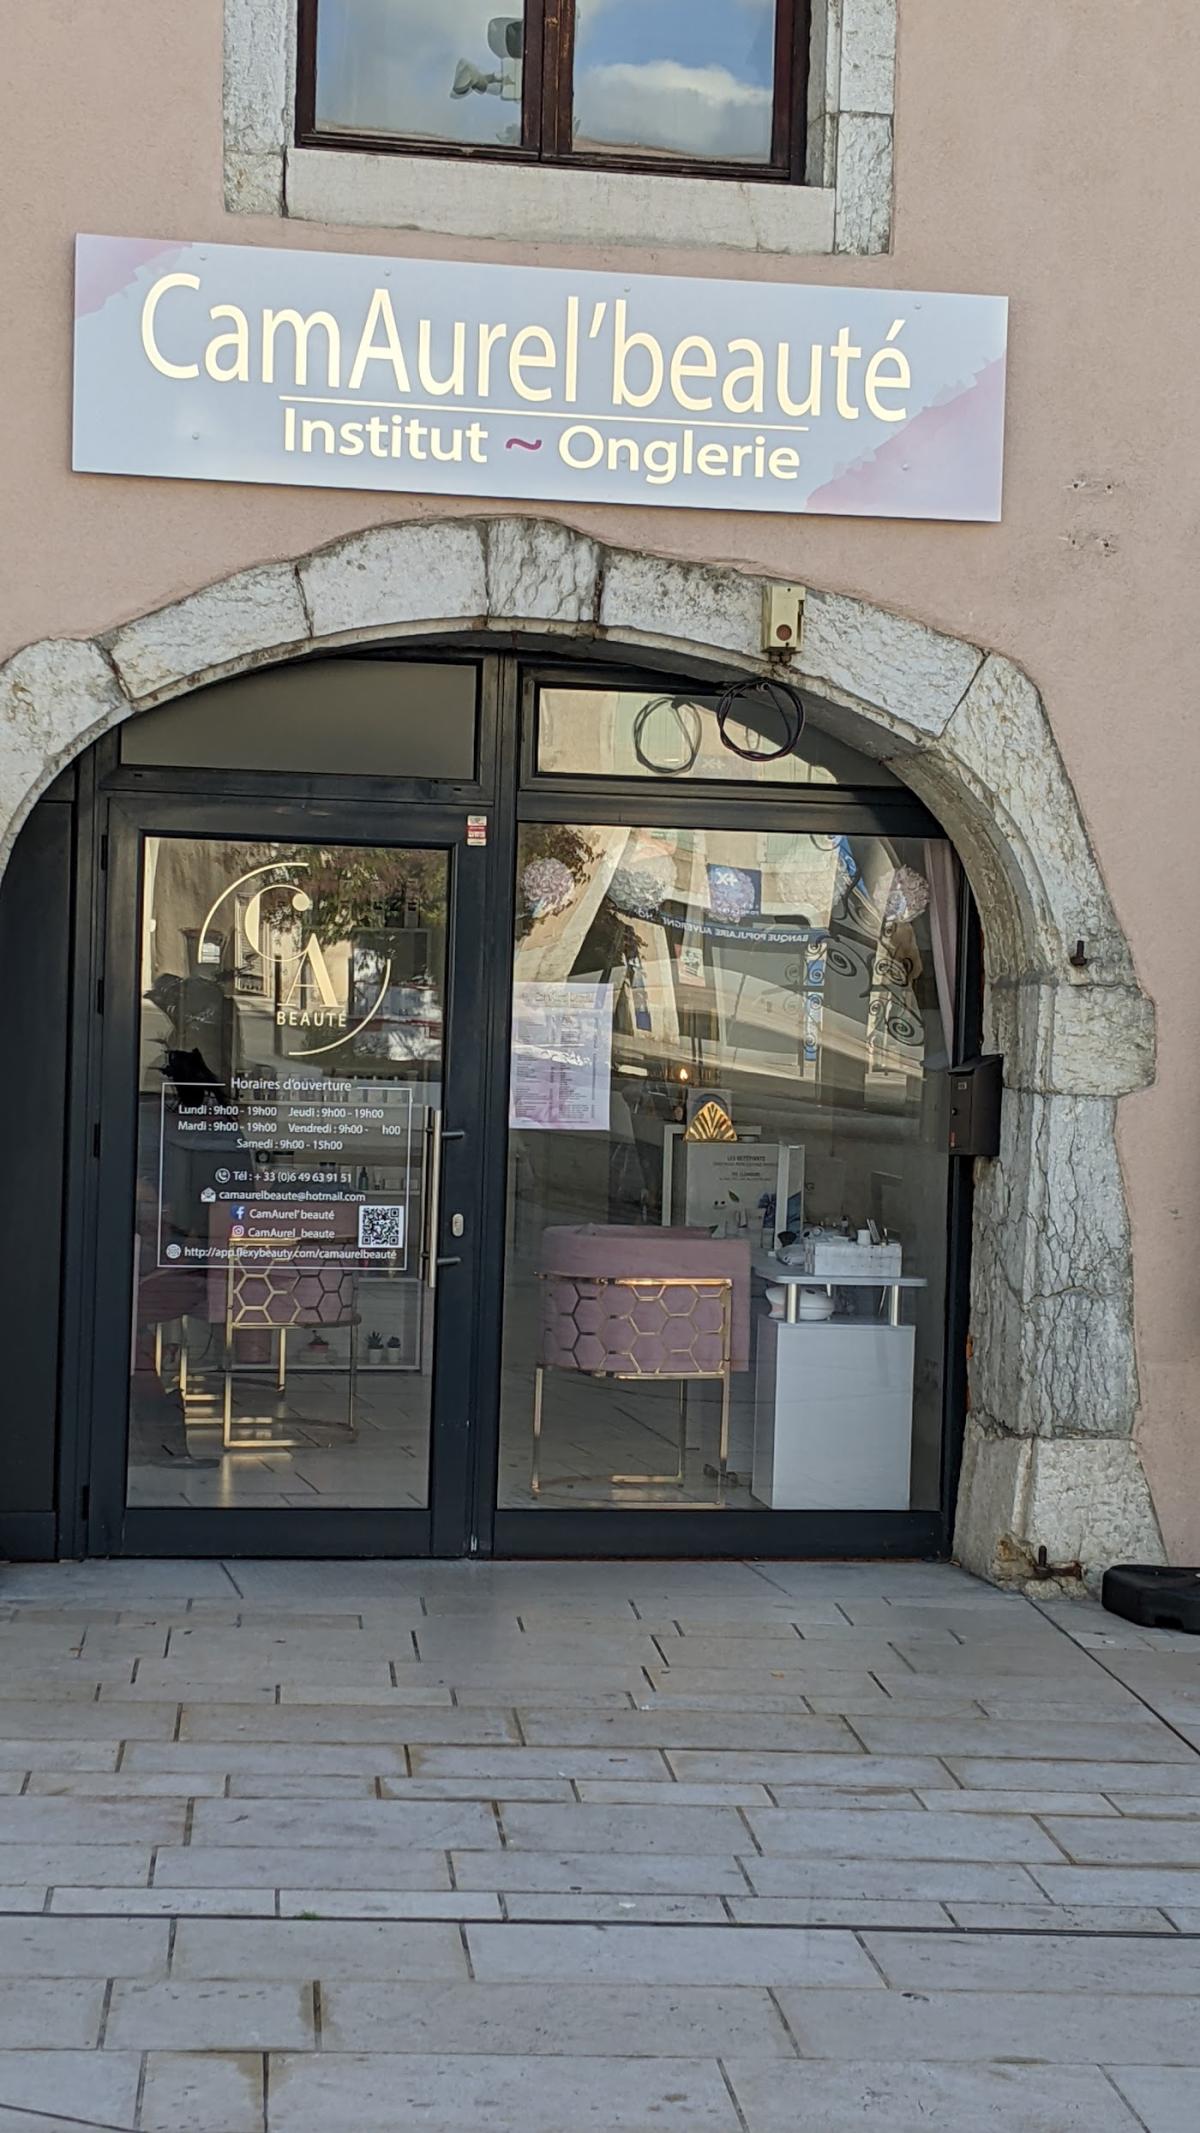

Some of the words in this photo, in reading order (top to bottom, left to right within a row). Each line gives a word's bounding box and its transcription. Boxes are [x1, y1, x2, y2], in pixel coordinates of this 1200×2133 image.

[141, 272, 910, 423] CamAurel'beauté
[284, 407, 488, 463] Institut
[558, 425, 800, 484] Onglerie
[276, 1009, 347, 1028] BEAUTÉ
[231, 1077, 280, 1090] Horaires
[283, 1078, 352, 1092] d'ouverture
[179, 1104, 207, 1115] Lundi
[213, 1106, 238, 1116] 9h00
[247, 1106, 278, 1117] 19h00
[288, 1107, 315, 1118] Jeudi
[321, 1108, 346, 1118] 9h00
[354, 1108, 384, 1118] 19h00
[178, 1120, 207, 1131] Mardi
[213, 1122, 238, 1132] 9h00
[247, 1122, 278, 1133] 19h00
[288, 1122, 332, 1133] Vendredi
[338, 1124, 363, 1134] 9h00
[236, 1138, 273, 1149] Samedi
[280, 1139, 304, 1149] 9h00
[313, 1140, 343, 1150] 15h00
[232, 1170, 247, 1181] Tél
[263, 1171, 276, 1182] 33
[277, 1171, 296, 1183] (0)6
[298, 1172, 311, 1182] 49
[312, 1172, 325, 1183] 63
[326, 1172, 338, 1183] 91
[340, 1173, 352, 1183] 51
[219, 1190, 366, 1202] camaurelbeaute@hotmail.com
